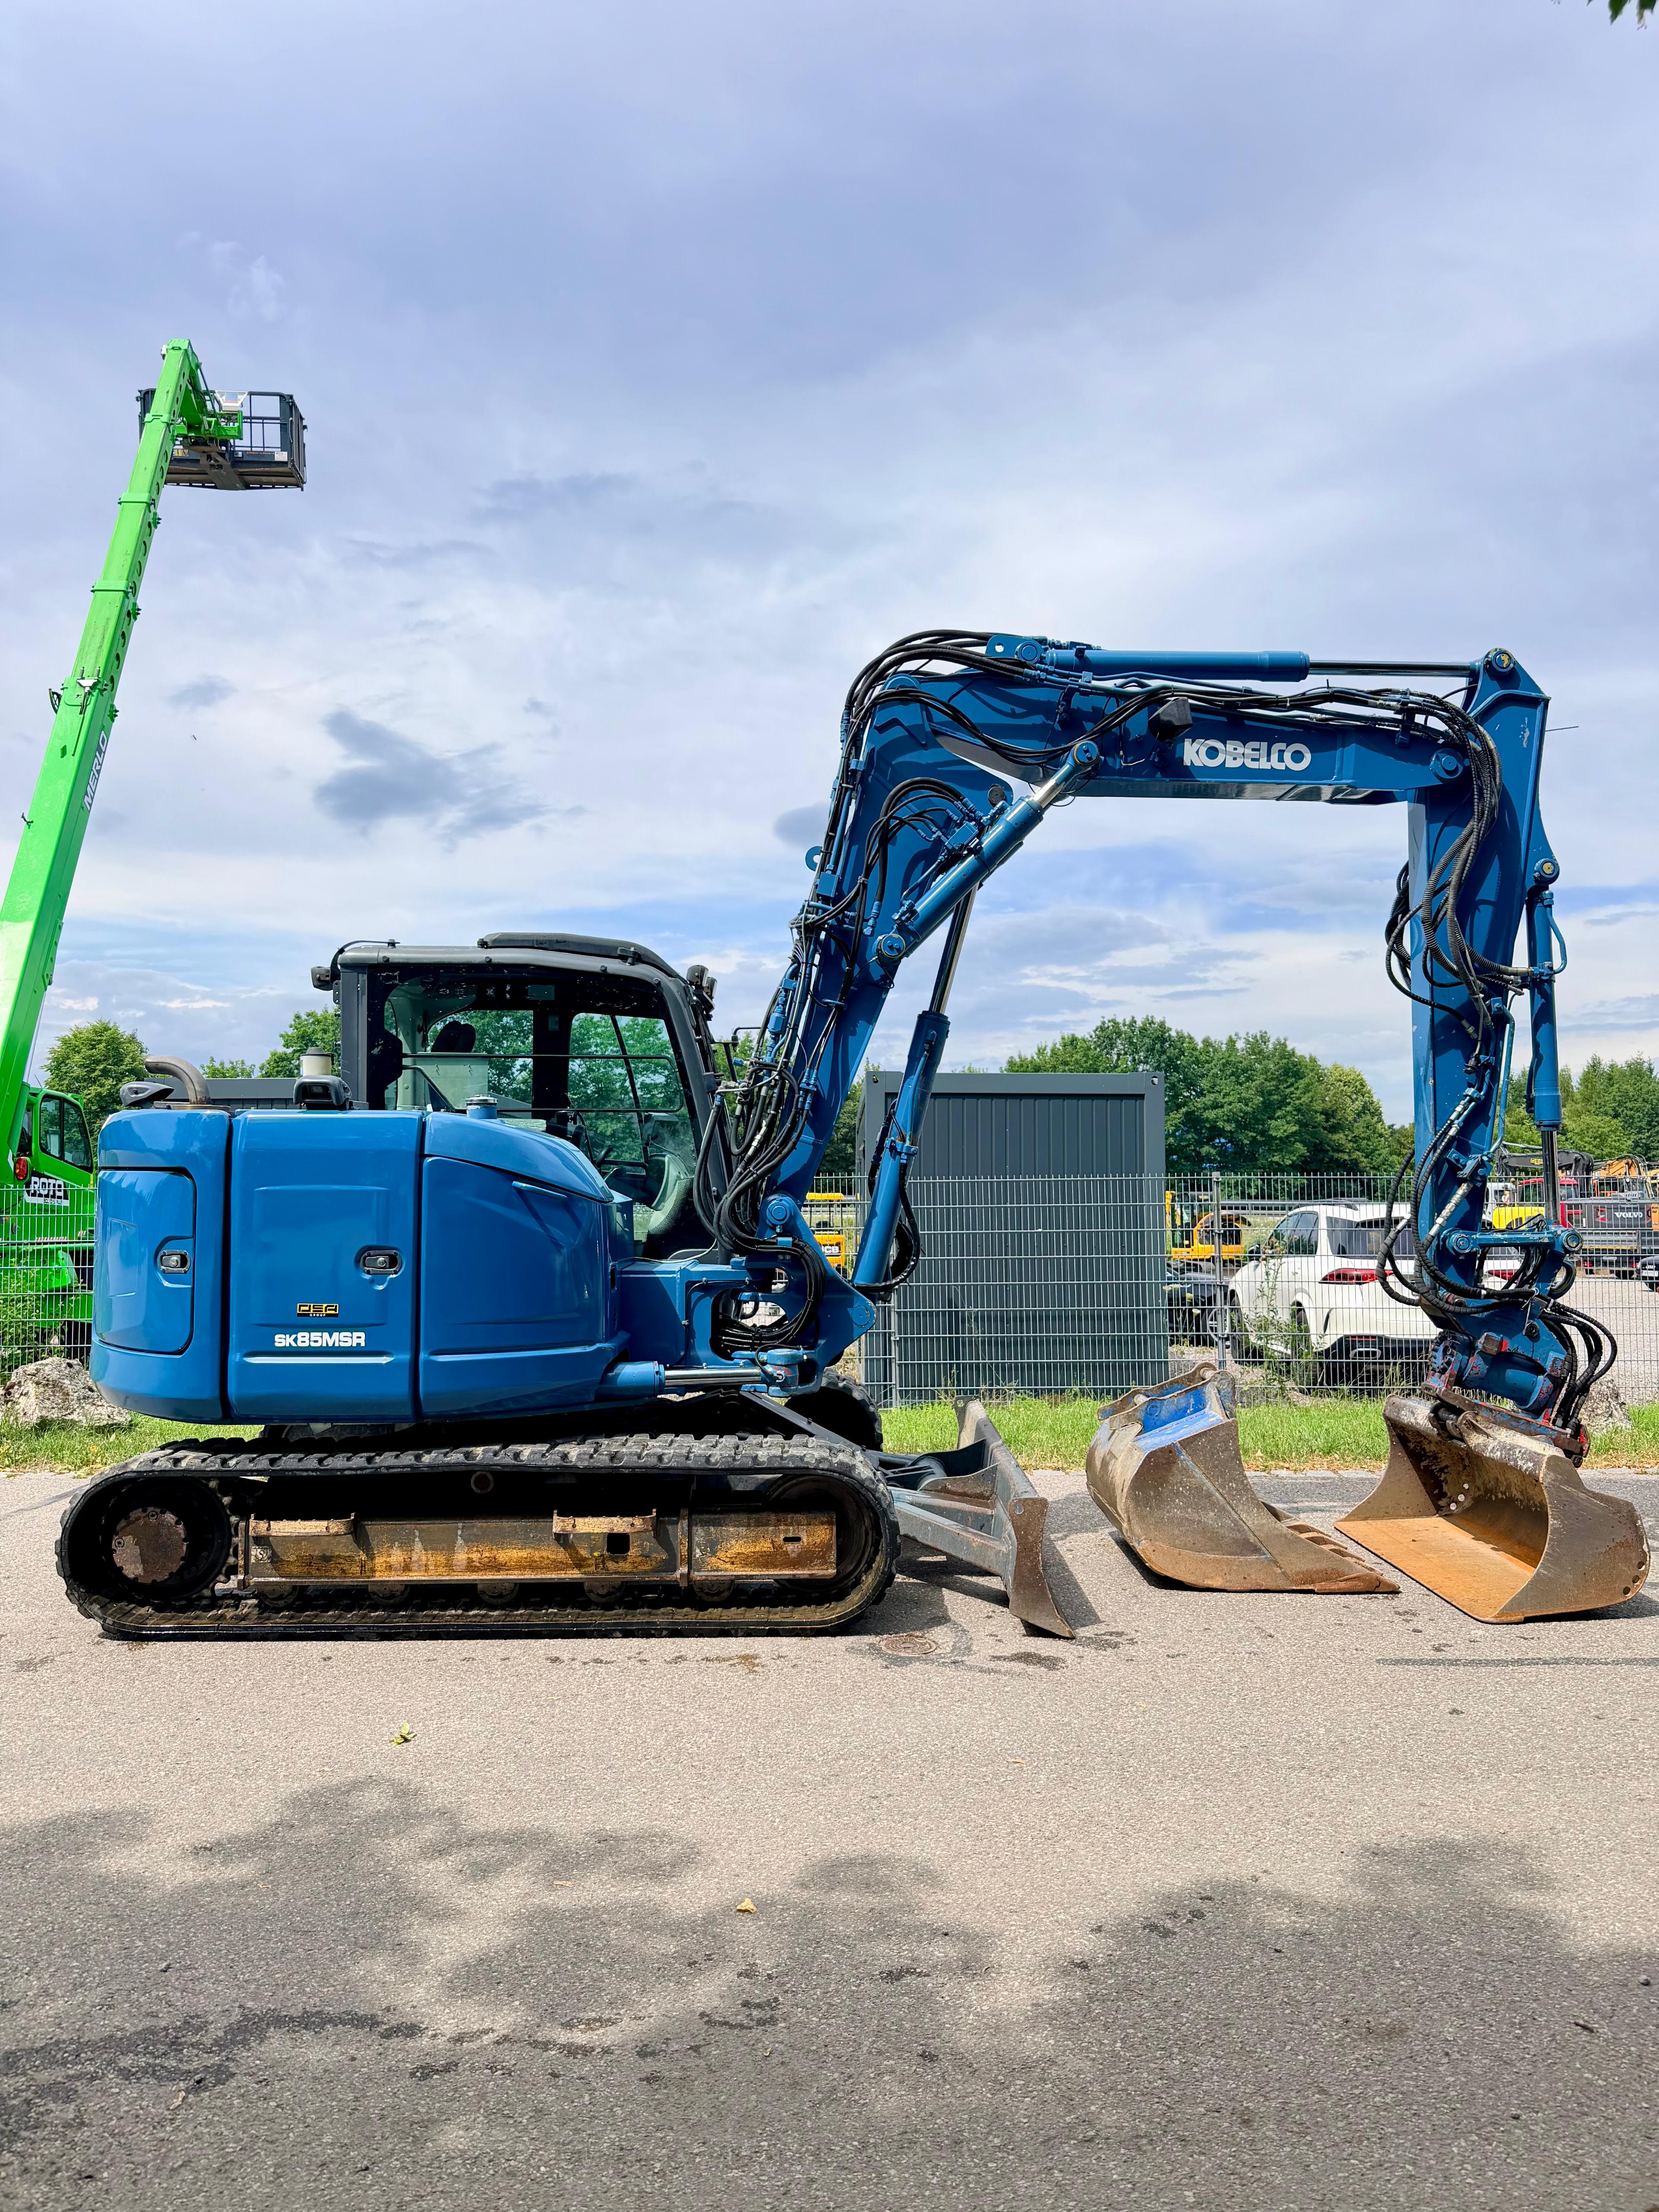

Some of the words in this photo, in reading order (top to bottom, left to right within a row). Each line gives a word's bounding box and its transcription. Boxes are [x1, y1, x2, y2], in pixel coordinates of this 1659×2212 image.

[1183, 738, 1311, 771] KOBELCO
[84, 730, 107, 811] MERLO
[31, 1176, 64, 1196] ROTO
[274, 1332, 365, 1347] SK85MSR
